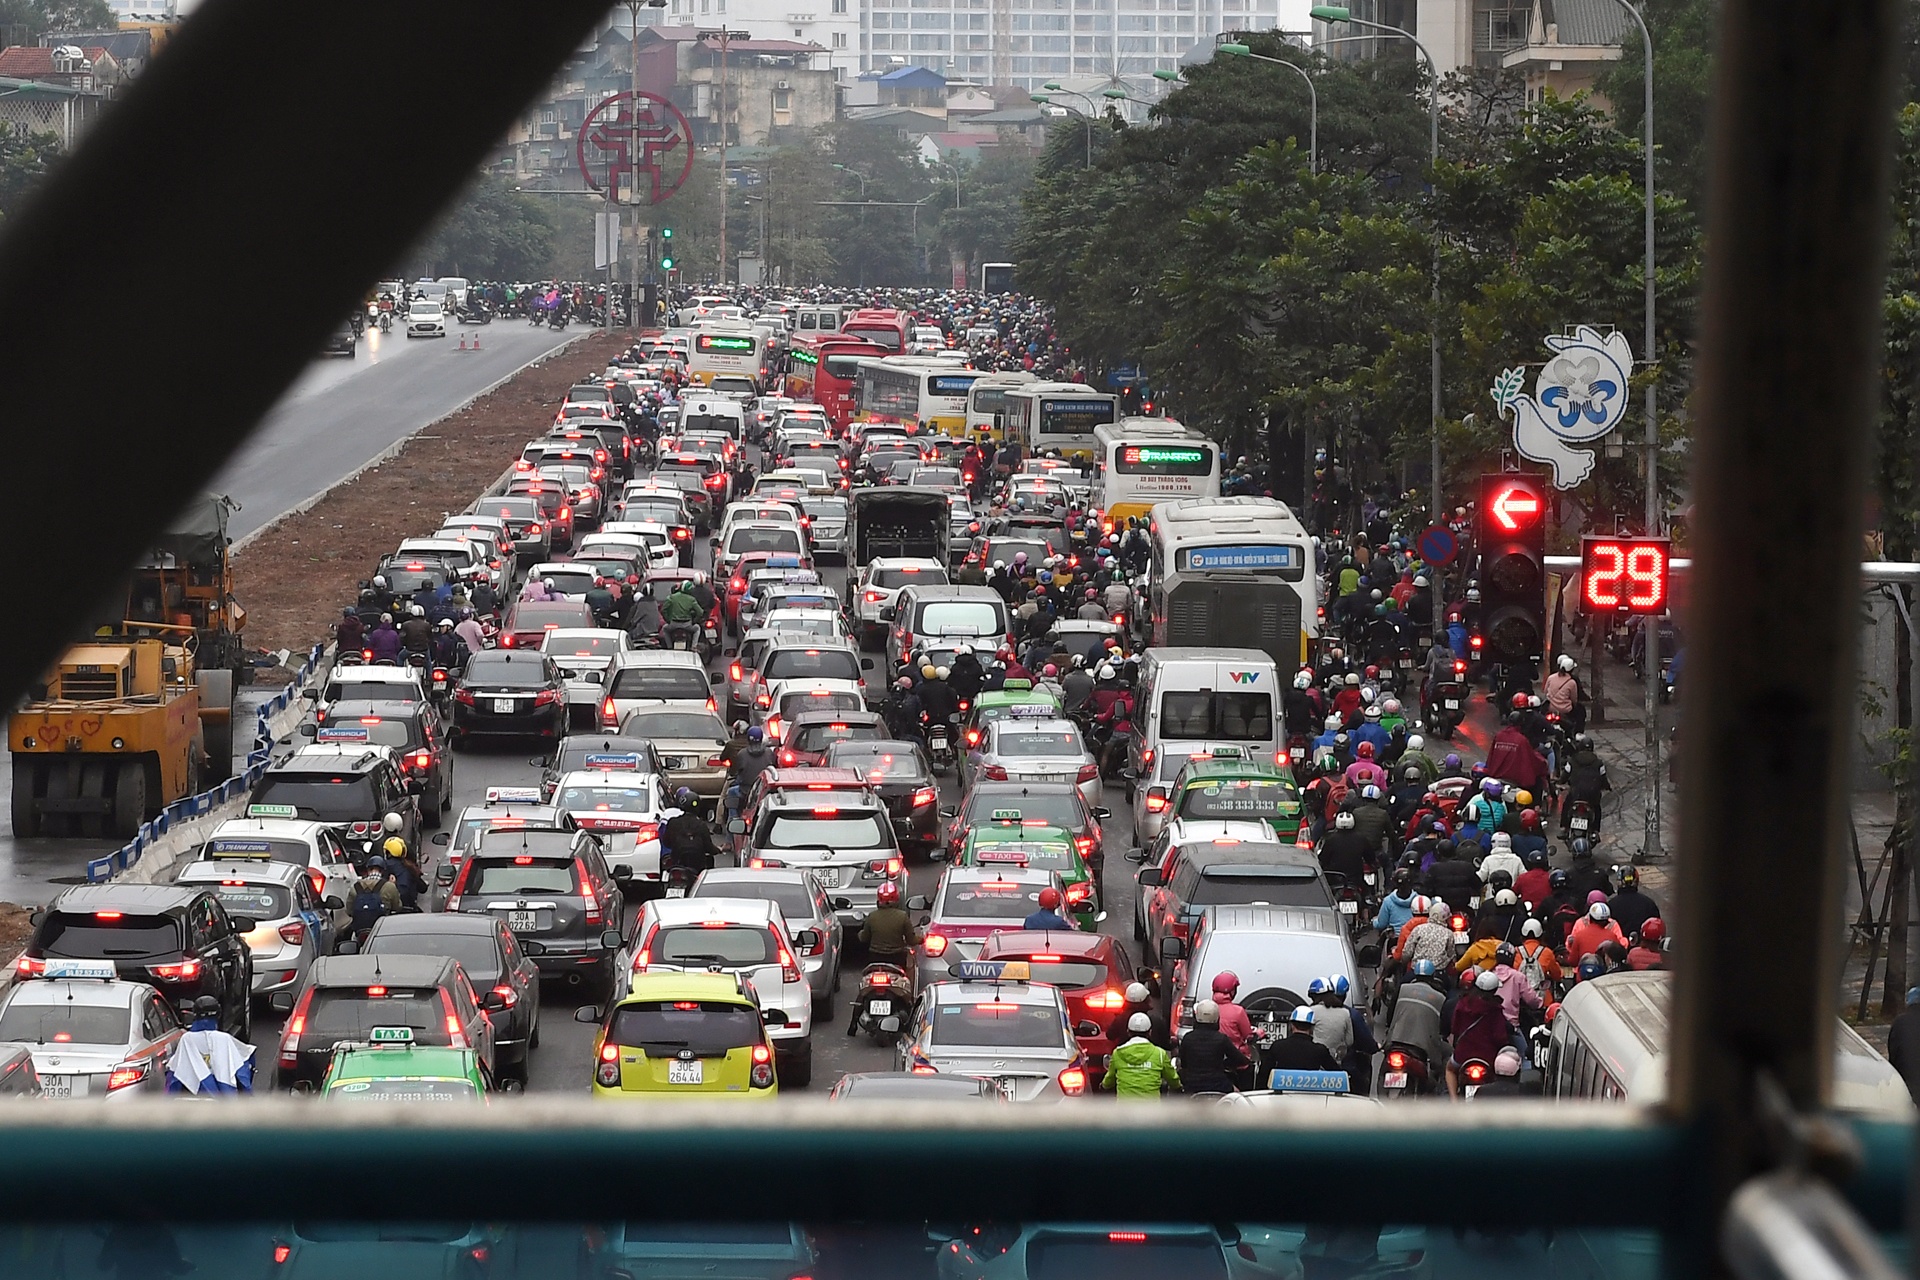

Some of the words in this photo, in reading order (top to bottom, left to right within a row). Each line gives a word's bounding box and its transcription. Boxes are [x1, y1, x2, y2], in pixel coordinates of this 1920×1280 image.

[1587, 545, 1664, 606] 29
[1229, 671, 1261, 684] VTV
[818, 869, 833, 878] 30E
[514, 912, 530, 921] 30A
[677, 1061, 694, 1072] 30E
[44, 1076, 63, 1087] 30A
[670, 1072, 701, 1084] 264.44
[1277, 1074, 1345, 1089] 38.222.888
